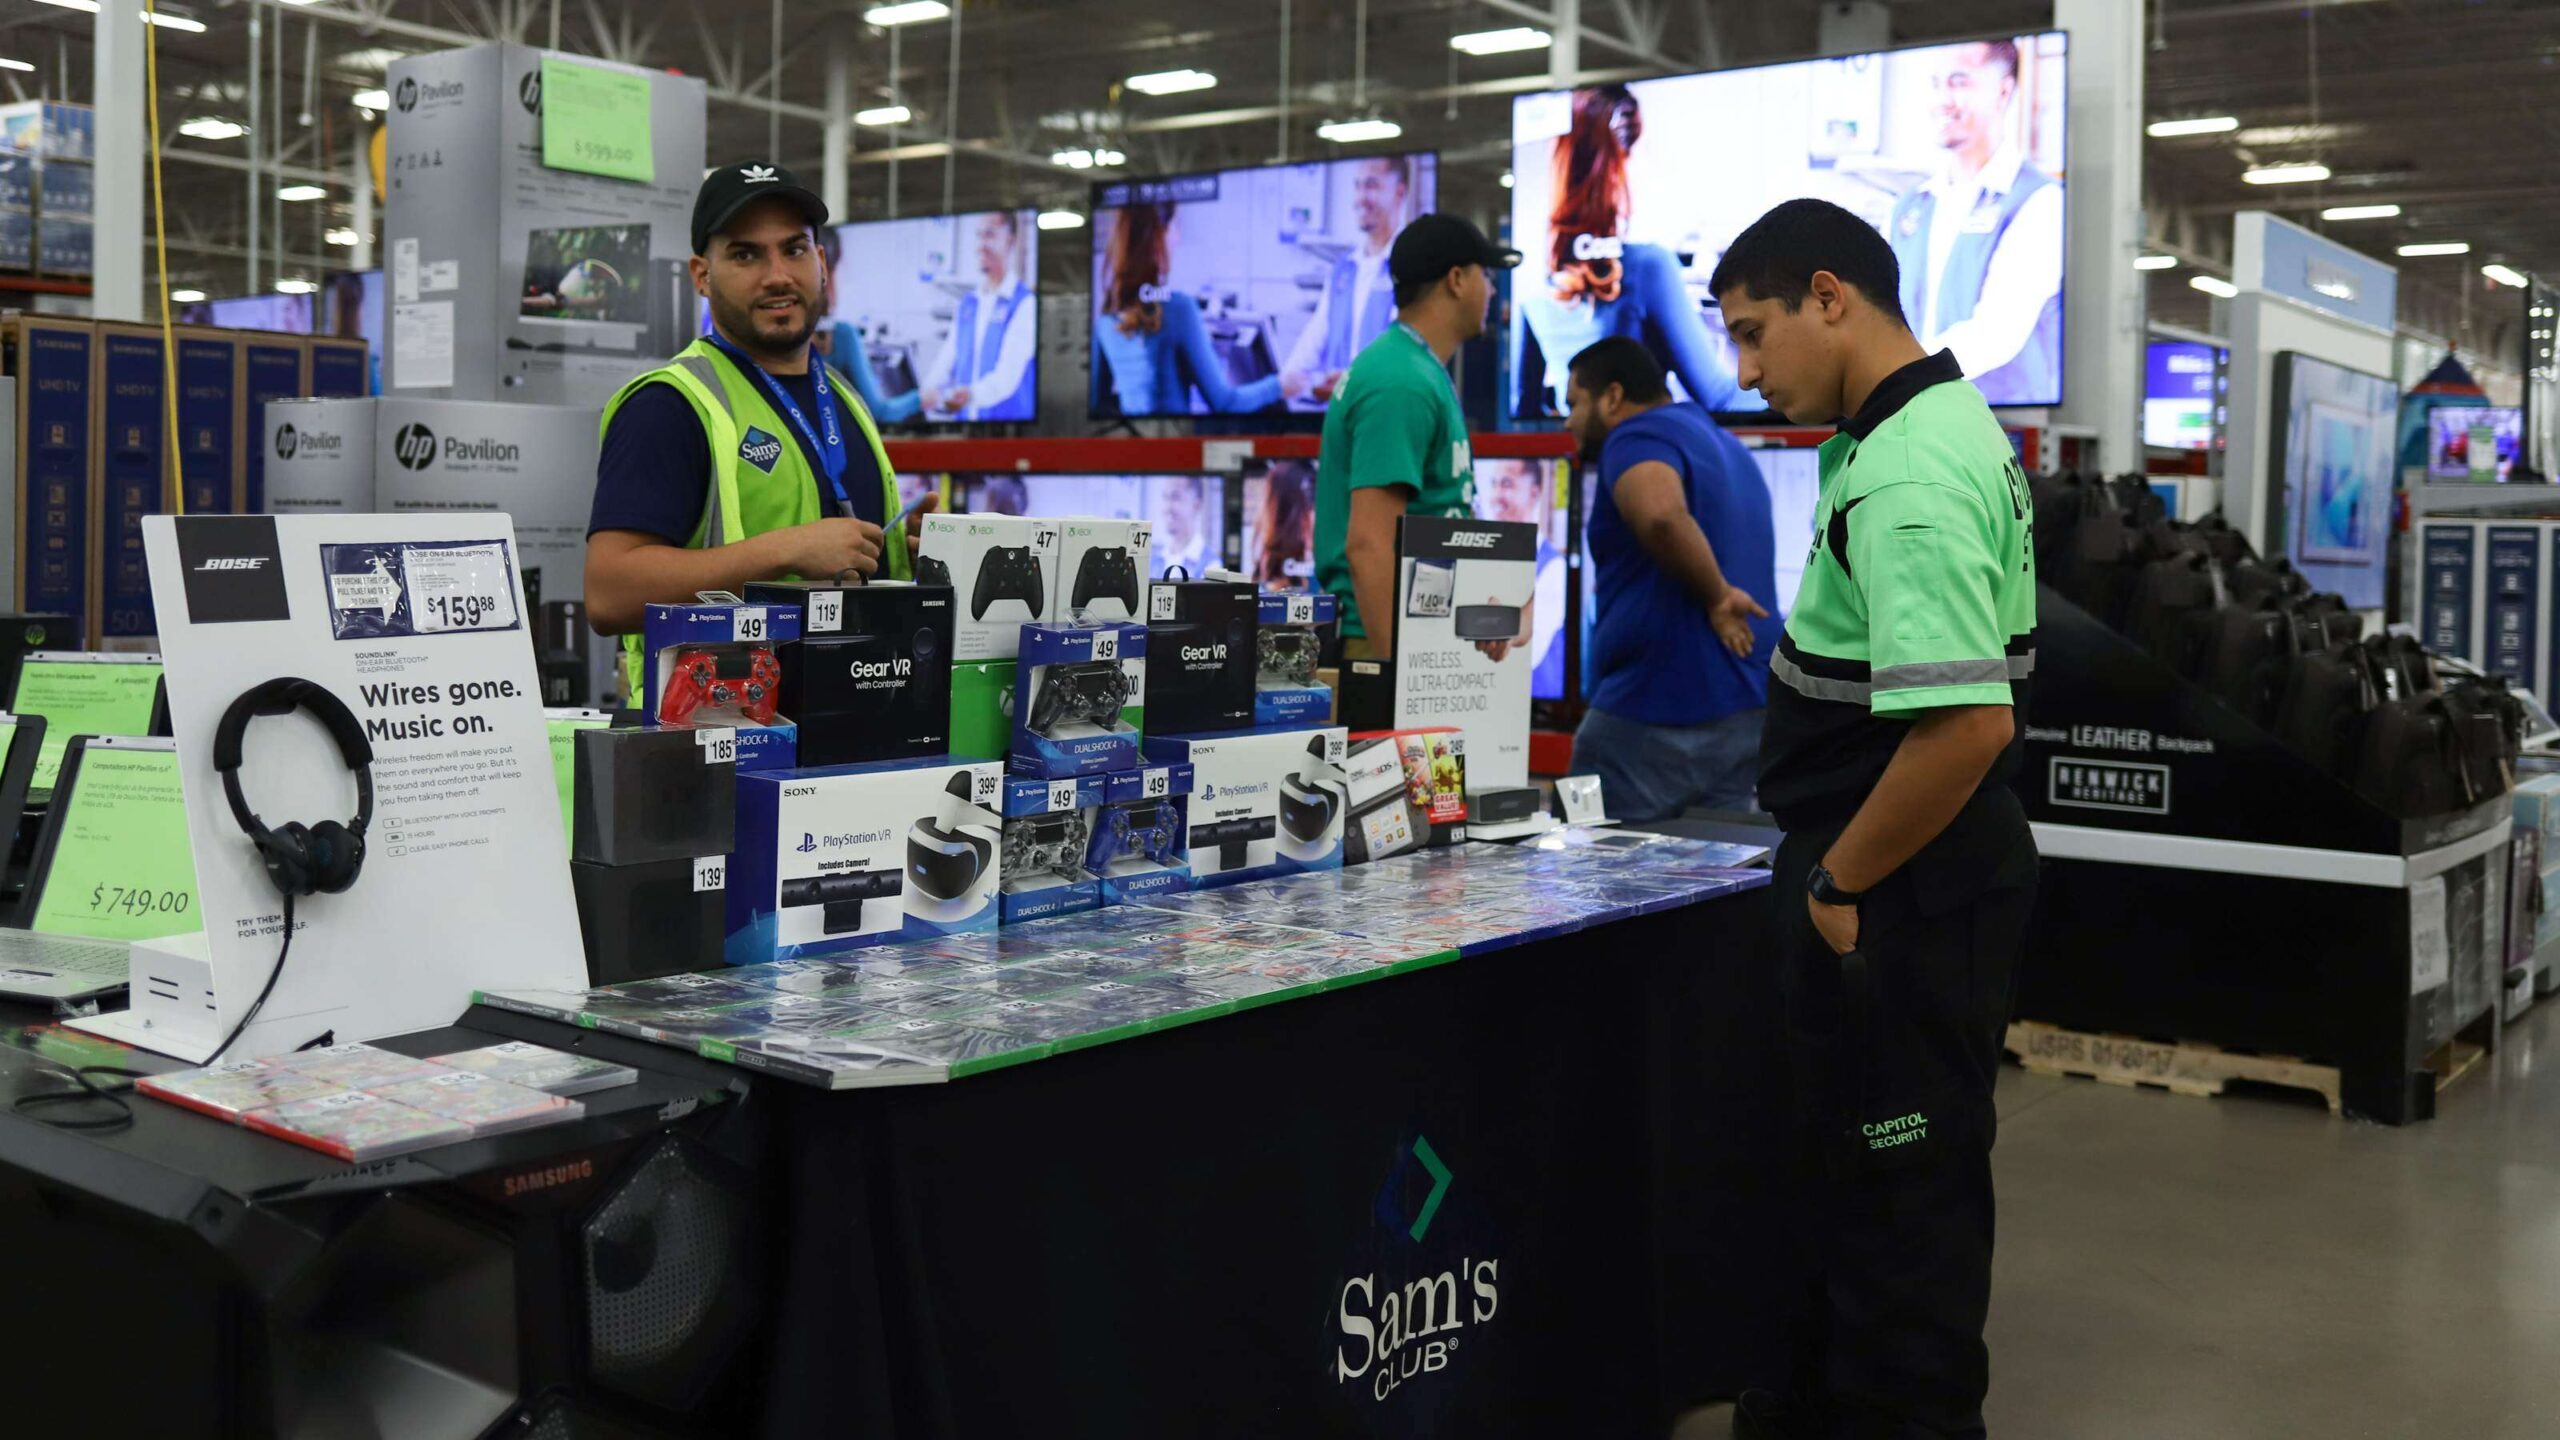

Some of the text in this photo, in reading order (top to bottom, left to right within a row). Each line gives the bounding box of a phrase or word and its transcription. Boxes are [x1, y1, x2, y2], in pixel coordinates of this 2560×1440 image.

[422, 81, 464, 97] Pavilion
[300, 432, 342, 451] Pavilion
[444, 437, 520, 462] Pavilion
[1442, 531, 1502, 548] BOSE
[194, 557, 270, 570] BOSE
[699, 614, 726, 622] PlayStation
[1181, 644, 1227, 661] Gear VR
[1408, 651, 1463, 669] WIRELESS.
[850, 658, 912, 678] Gear VR
[1184, 662, 1224, 671] with Controller
[856, 680, 906, 690] with Controller
[1406, 672, 1497, 692] ULTRA-COMPACT.
[360, 680, 522, 708] Wires gone.
[1272, 696, 1306, 706] DUALSHOCK
[1406, 696, 1488, 715] BETTER SOUND.
[366, 714, 494, 742] Music on.
[1074, 740, 1118, 754] DUALSHOCK 4
[2072, 725, 2215, 754] LEATHER Backpack
[374, 746, 513, 766] Wireless freedom will make you put
[1192, 746, 1216, 755] SONY
[375, 758, 517, 779] them on everywhere you go. But it's
[377, 770, 522, 792] the sound and comfort that will keep
[2058, 766, 2160, 793] RENWICK
[379, 798, 396, 807] you
[397, 794, 417, 804] from
[418, 792, 444, 802] taking
[446, 790, 466, 799] them
[784, 786, 817, 797] SONY
[1025, 788, 1046, 796] PlayStation
[479, 808, 506, 816] PROMPTS
[414, 830, 436, 838] HOURS
[471, 838, 490, 846] CALLS
[818, 857, 870, 870] Includes Camera!
[1128, 878, 1165, 890] DUALSHOCK
[1017, 905, 1050, 916] DUALSHOCK
[236, 914, 282, 928] TRY THEM
[238, 922, 309, 938] FOR YOURELF.
[1862, 1112, 1928, 1136] CAPITOL
[1869, 1127, 1927, 1150] SECURITY
[504, 1159, 592, 1196] SAMSUNG
[1338, 1257, 1498, 1384] Sam's
